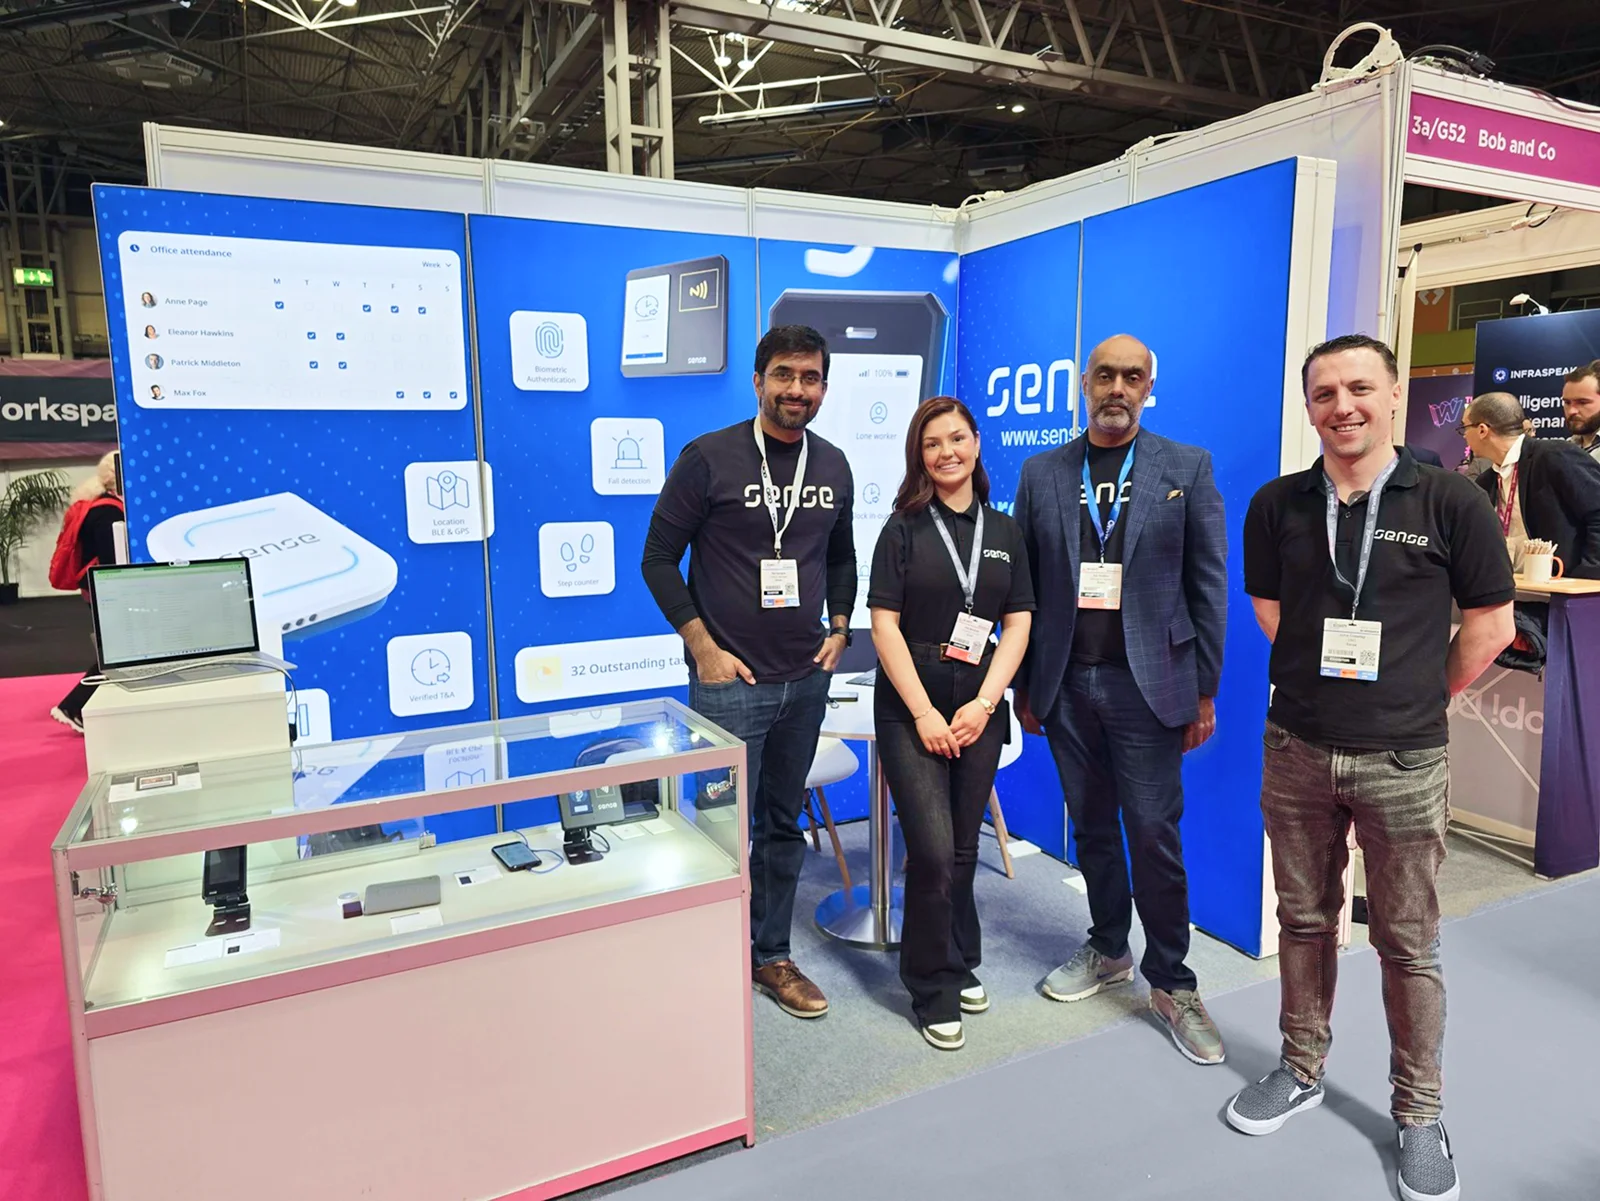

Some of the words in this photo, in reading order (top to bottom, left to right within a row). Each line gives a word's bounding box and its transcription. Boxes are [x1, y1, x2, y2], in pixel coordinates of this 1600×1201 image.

[1411, 115, 1466, 144] 3a/G52
[1478, 129, 1507, 151] Bob
[1509, 138, 1535, 157] and
[1537, 141, 1556, 161] Co
[150, 245, 178, 254] Office
[180, 248, 232, 257] attendance
[187, 298, 208, 307] Page
[168, 328, 198, 336] Eleanor
[200, 329, 234, 337] Hawkins
[201, 359, 241, 367] Middleton
[534, 365, 568, 373] Biometric
[874, 369, 893, 377] 100%
[526, 375, 577, 384] Authentication
[0, 396, 117, 427] orkspa
[855, 431, 873, 440] Lone
[874, 431, 898, 440] worker
[432, 518, 465, 526] Location
[431, 528, 446, 536] BLE
[454, 527, 470, 535] GPS
[1373, 529, 1429, 546] sense
[571, 665, 586, 676] 32
[589, 657, 665, 674] Outstanding
[409, 692, 439, 702] Verified
[440, 691, 456, 699] T&A
